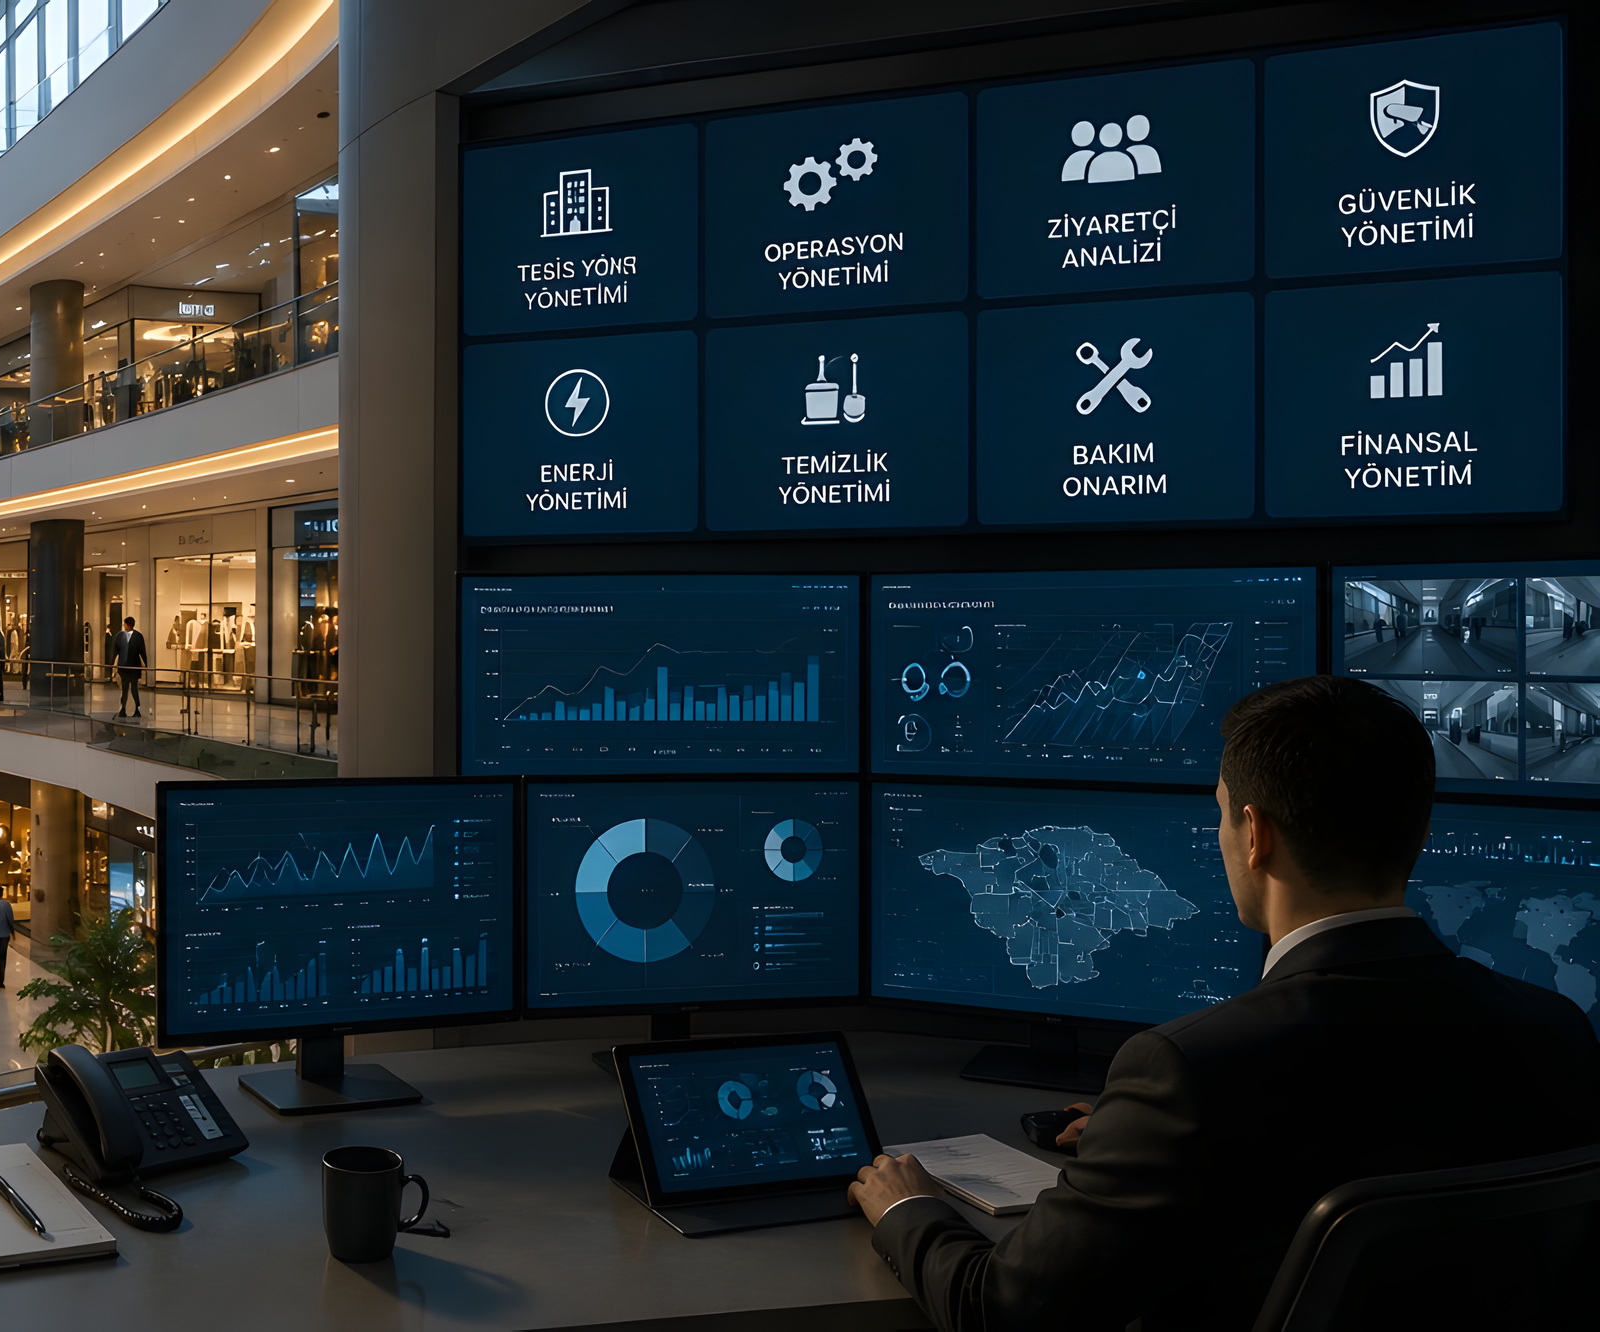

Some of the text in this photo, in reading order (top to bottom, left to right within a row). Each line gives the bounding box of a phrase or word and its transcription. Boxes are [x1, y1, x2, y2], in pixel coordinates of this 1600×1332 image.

[1338, 180, 1477, 215] GÜVENLİK
[1047, 203, 1176, 239] ZİYARETÇİ
[1340, 212, 1473, 248] YÖNETİMİ
[764, 231, 904, 263] OPERASYON
[1061, 236, 1161, 269] ANALİZİ
[517, 256, 575, 282] TESİS
[1073, 441, 1154, 466] BAKIM
[1341, 430, 1478, 456] FİNANSAL
[540, 458, 613, 483] ENERJİ
[780, 448, 888, 475] TEMİZLİK
[1062, 473, 1167, 497] ONARIM
